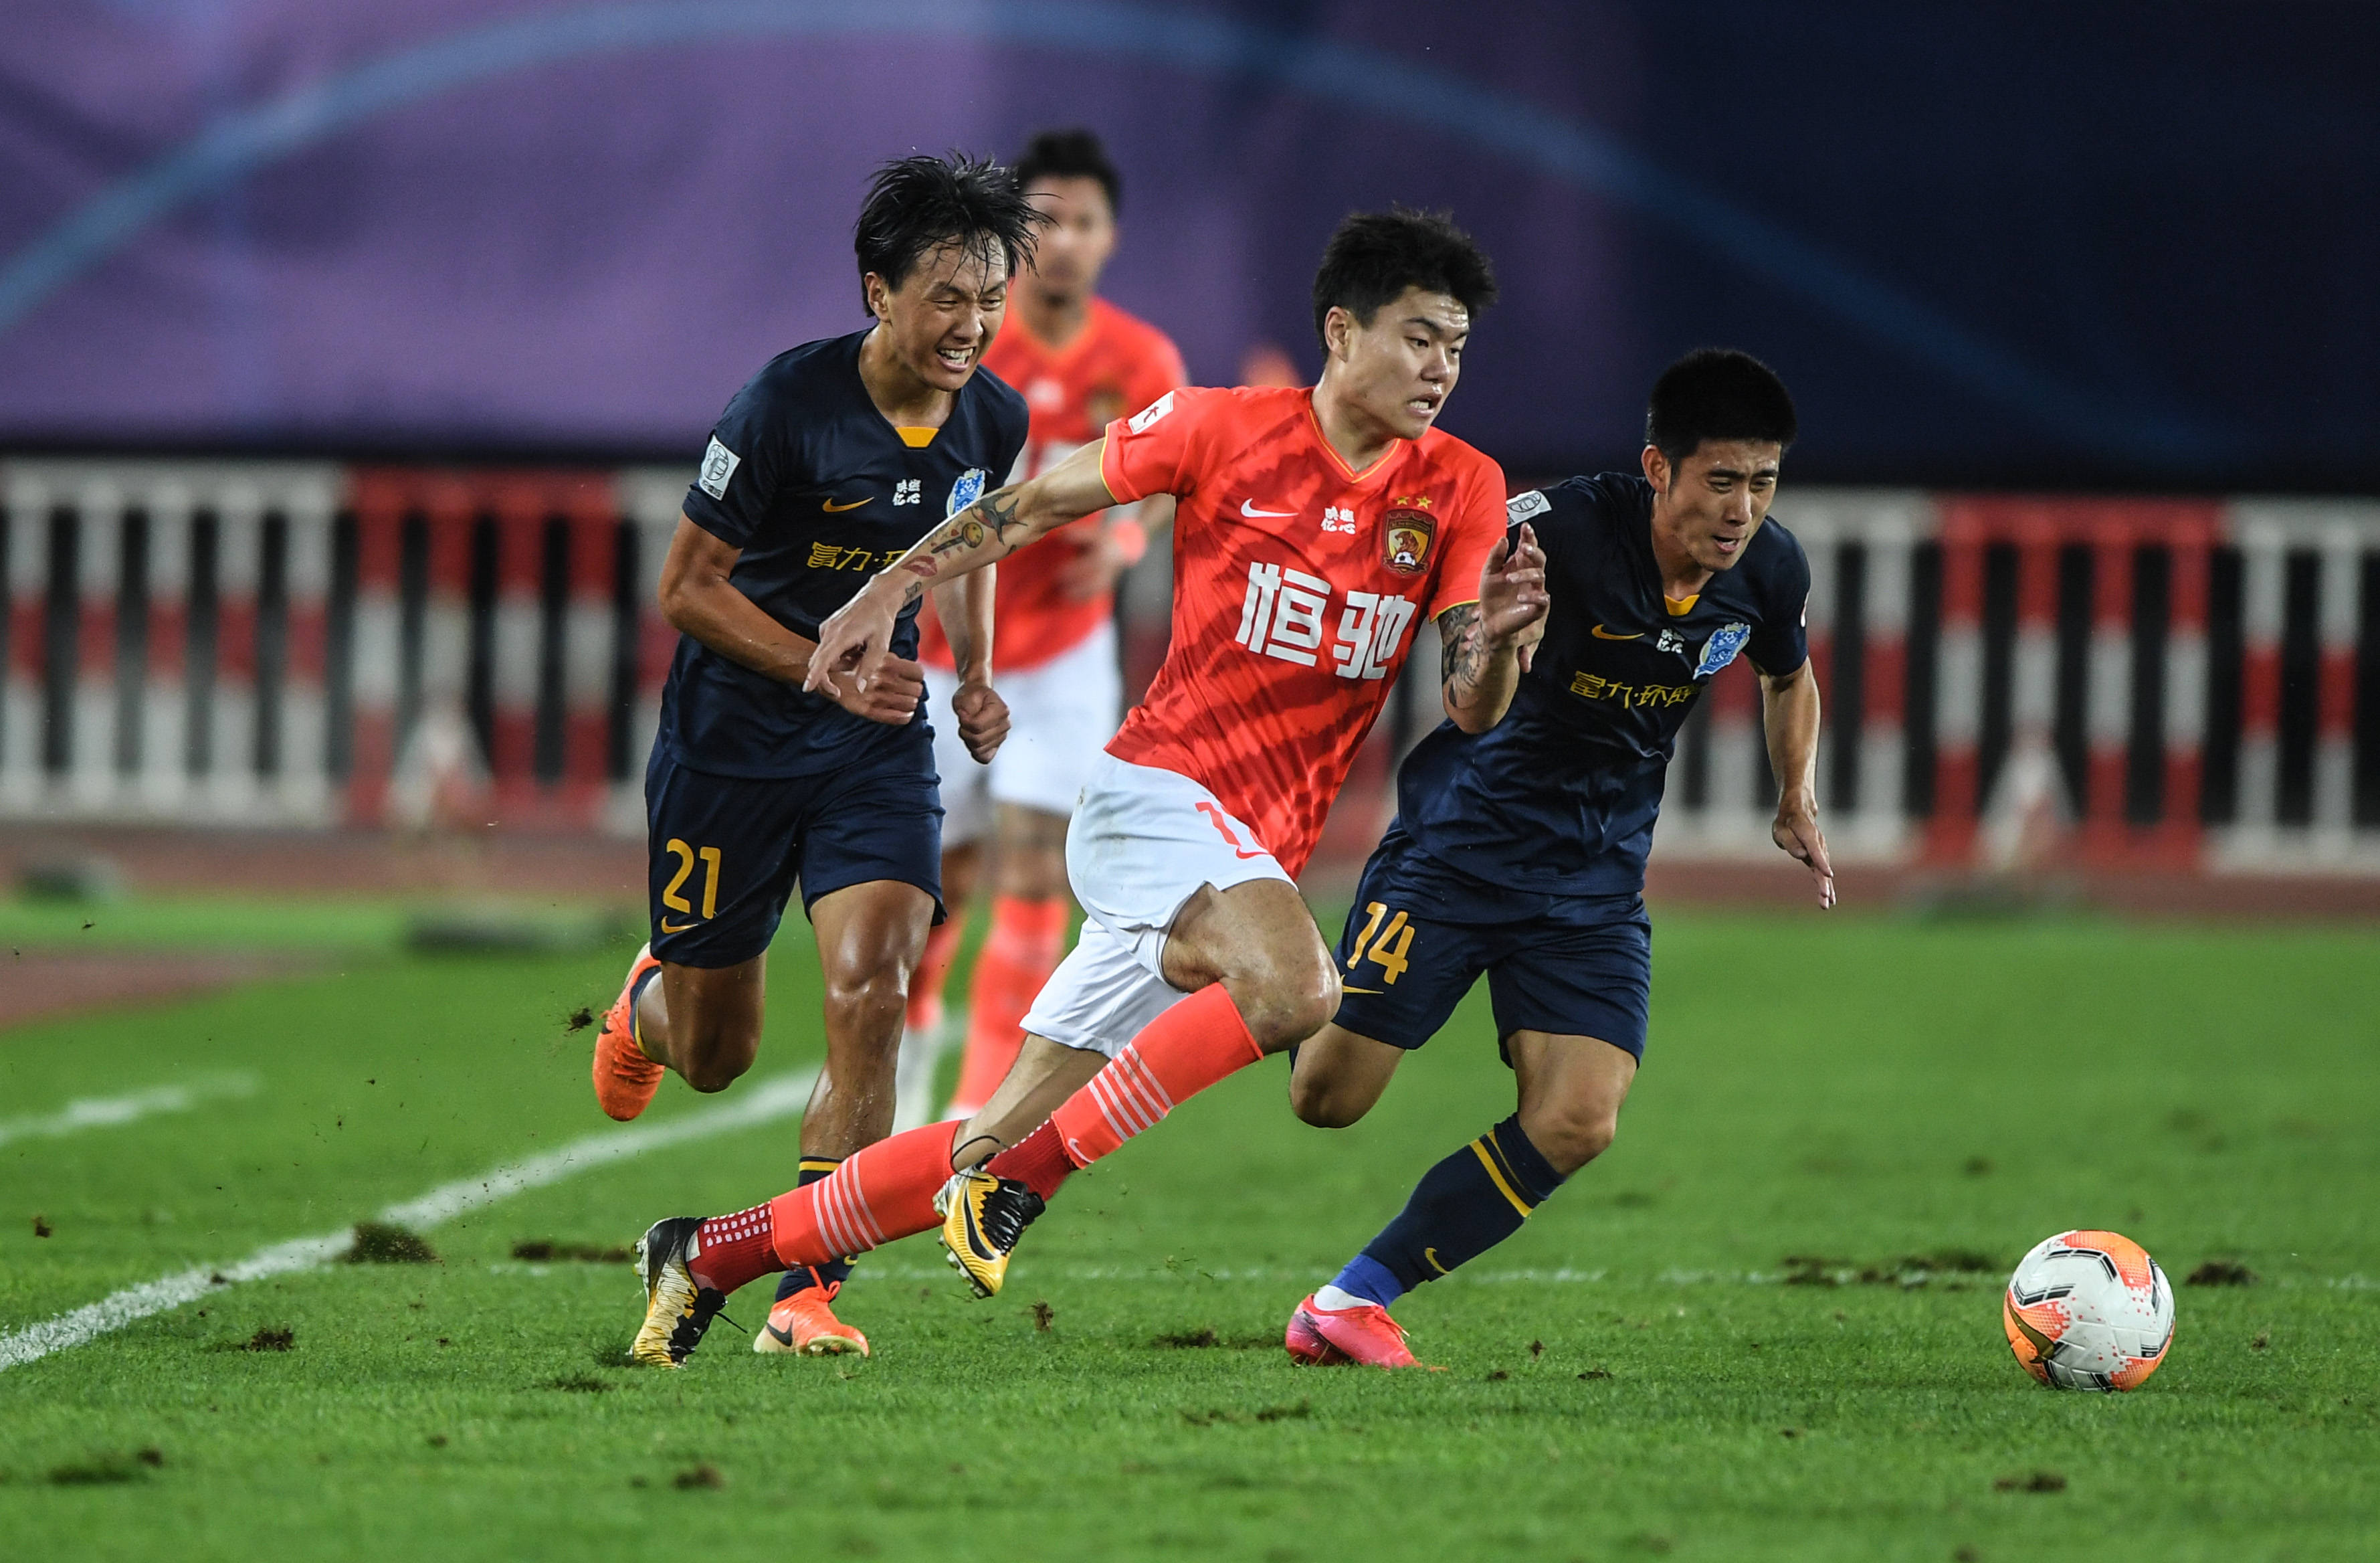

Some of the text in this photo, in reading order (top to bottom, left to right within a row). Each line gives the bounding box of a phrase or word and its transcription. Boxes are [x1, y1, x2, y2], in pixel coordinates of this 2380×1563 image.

[1235, 561, 1417, 679] 恒驰
[663, 838, 721, 919] 21
[1347, 901, 1415, 985] 14
